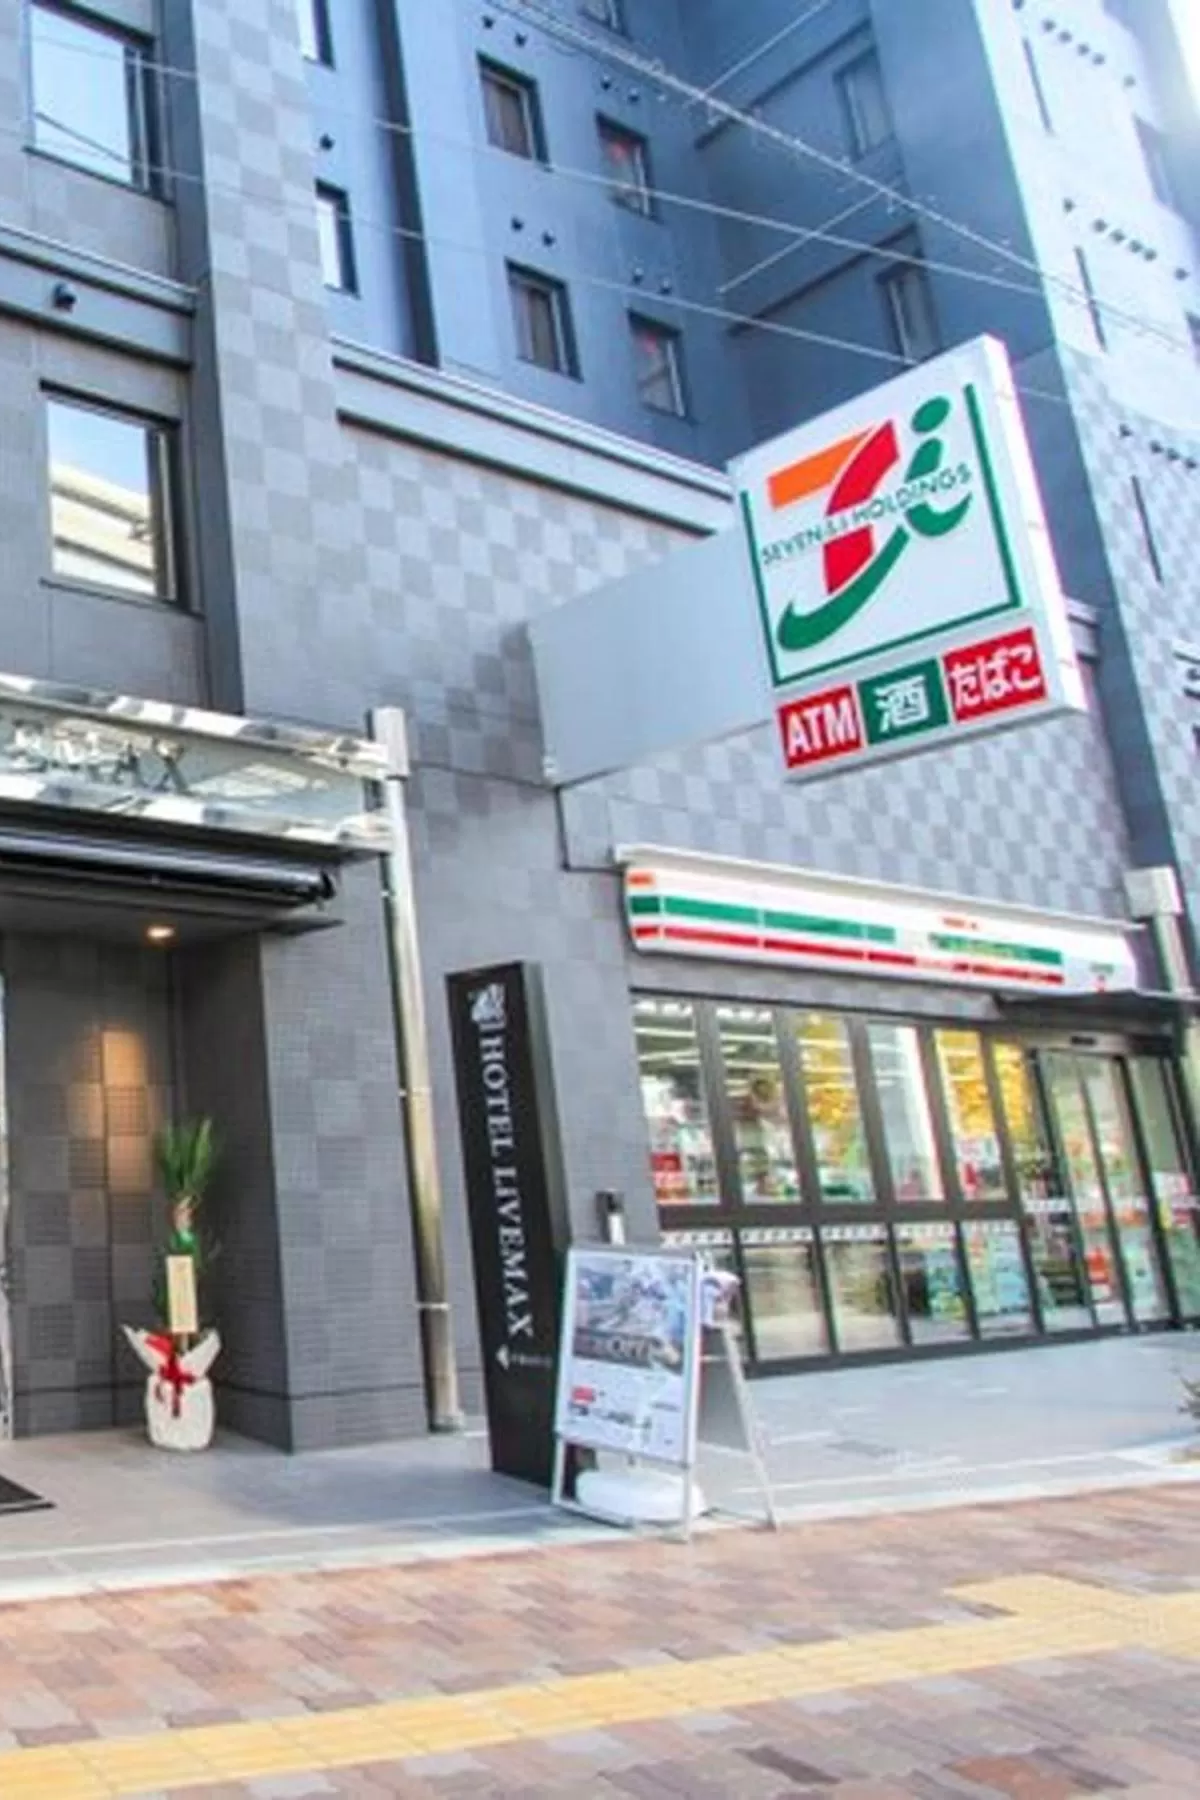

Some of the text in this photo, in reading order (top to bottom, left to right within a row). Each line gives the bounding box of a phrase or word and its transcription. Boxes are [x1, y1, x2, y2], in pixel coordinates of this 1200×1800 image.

[853, 463, 972, 524] HOLDINGS
[874, 674, 930, 732] 酒
[950, 644, 1040, 711] たばこ
[787, 696, 857, 757] ATM
[479, 1035, 515, 1157] HOTEL
